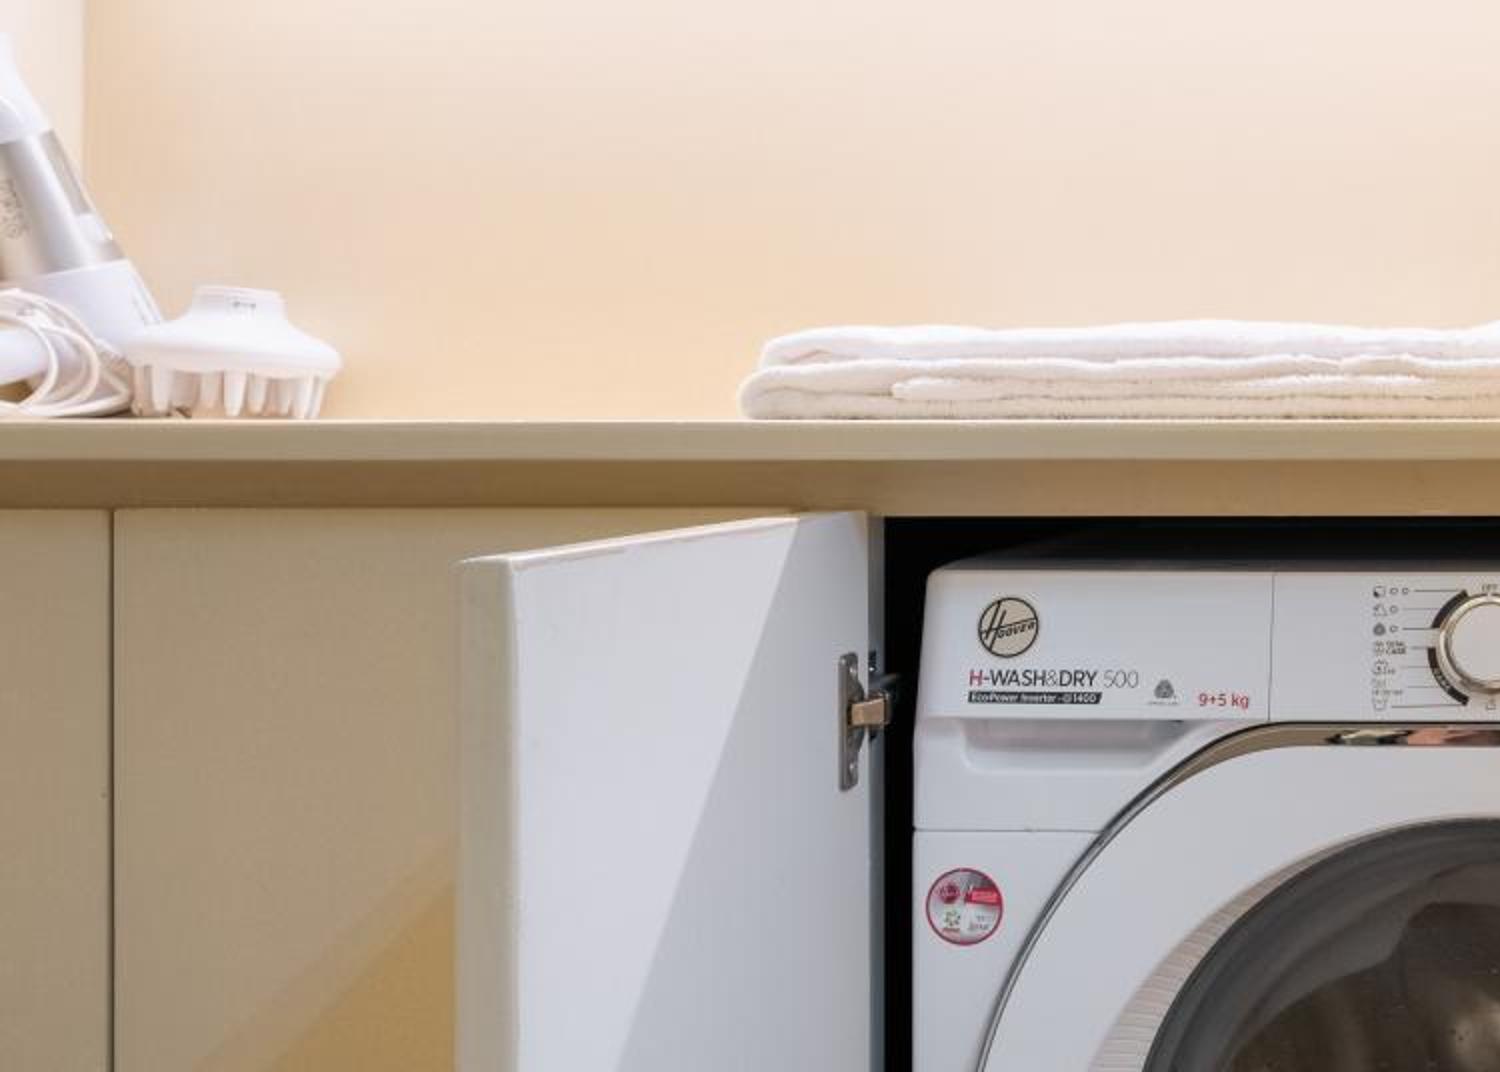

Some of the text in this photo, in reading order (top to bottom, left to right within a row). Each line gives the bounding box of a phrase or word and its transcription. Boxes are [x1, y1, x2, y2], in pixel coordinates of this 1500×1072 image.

[969, 669, 1140, 689] H-WASH&DRY 500
[1199, 692, 1249, 710] 9+5 kg
